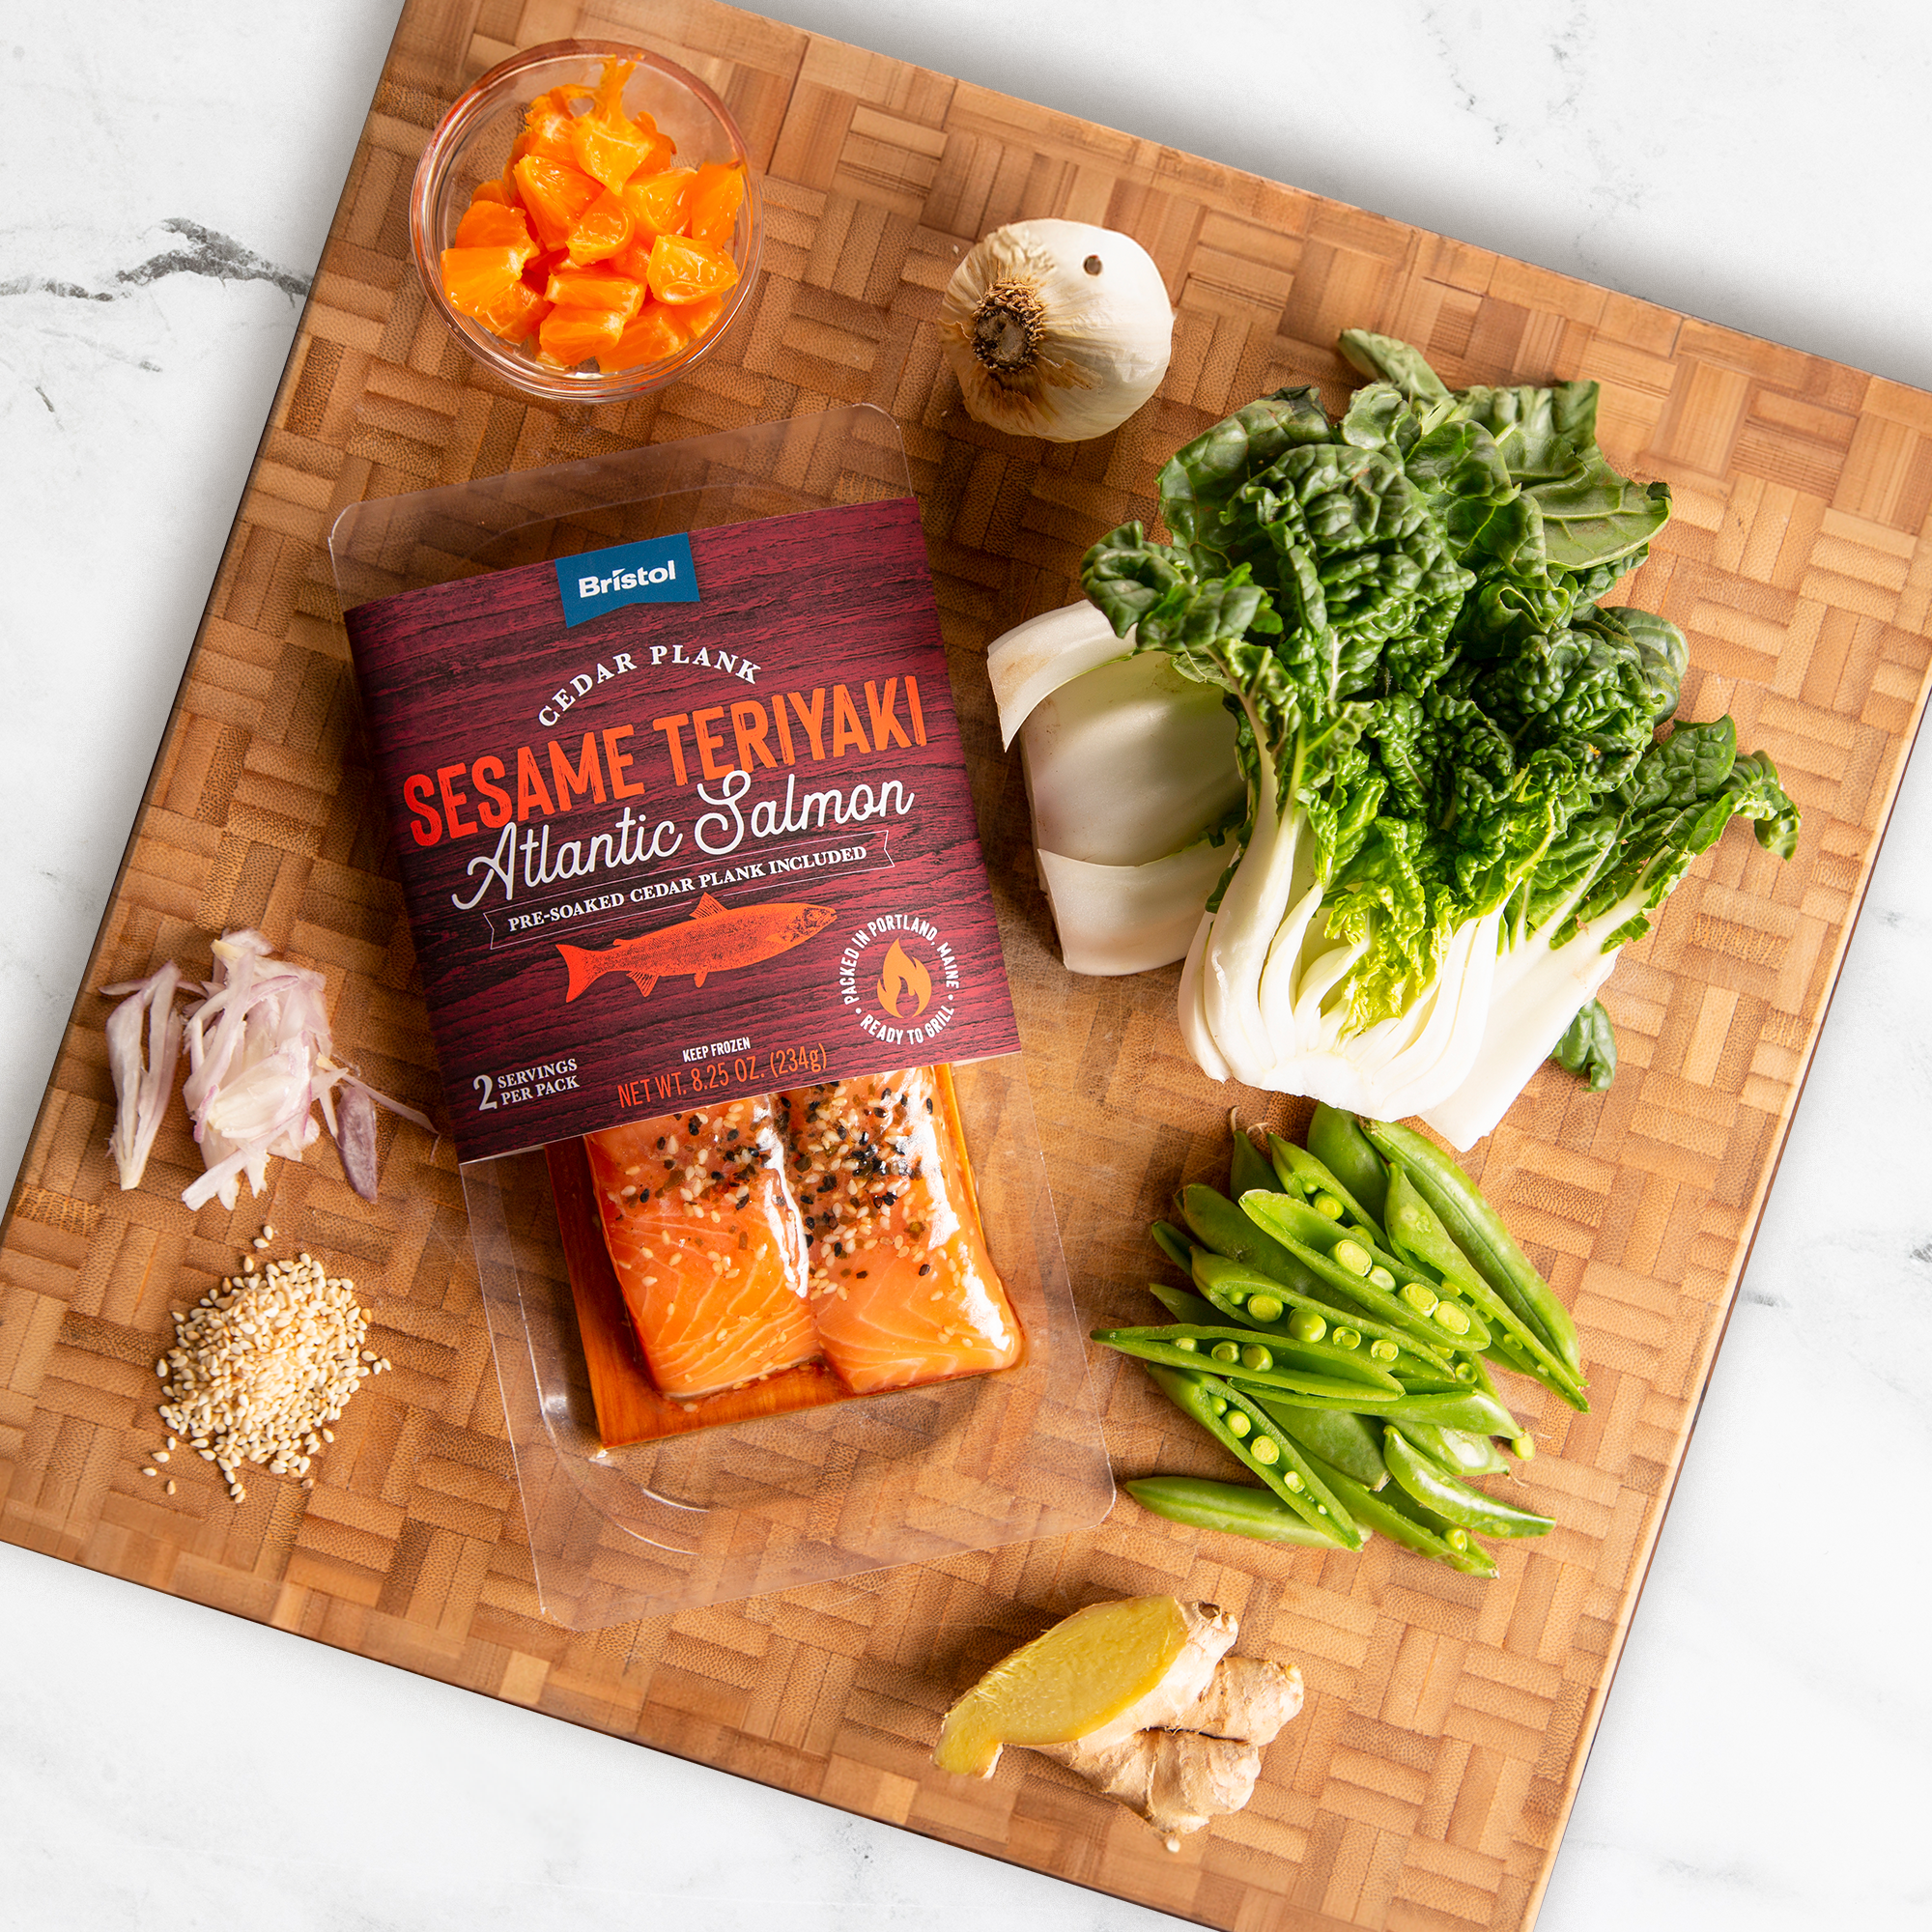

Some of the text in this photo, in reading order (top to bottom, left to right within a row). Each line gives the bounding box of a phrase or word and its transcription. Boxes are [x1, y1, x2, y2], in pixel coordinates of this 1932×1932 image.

[538, 644, 761, 726] CEDAR PLANK
[403, 675, 927, 847] SESAME TERIYAKI
[452, 770, 915, 910] Atlantic Salmon
[508, 845, 867, 932] PRE-SOAKED CEDAR PLANK INCLUDED
[839, 915, 959, 1005] PACKED IN PORTLAND, MAINE
[682, 1037, 752, 1063] KEEP FROZEN
[860, 1005, 954, 1044] READY TO GRILL
[472, 1074, 497, 1111] 2
[497, 1059, 578, 1089] SERVINGS
[500, 1075, 581, 1106] PER PACK
[617, 1042, 827, 1109] NET WT. 8.25 OZ. (234g)
